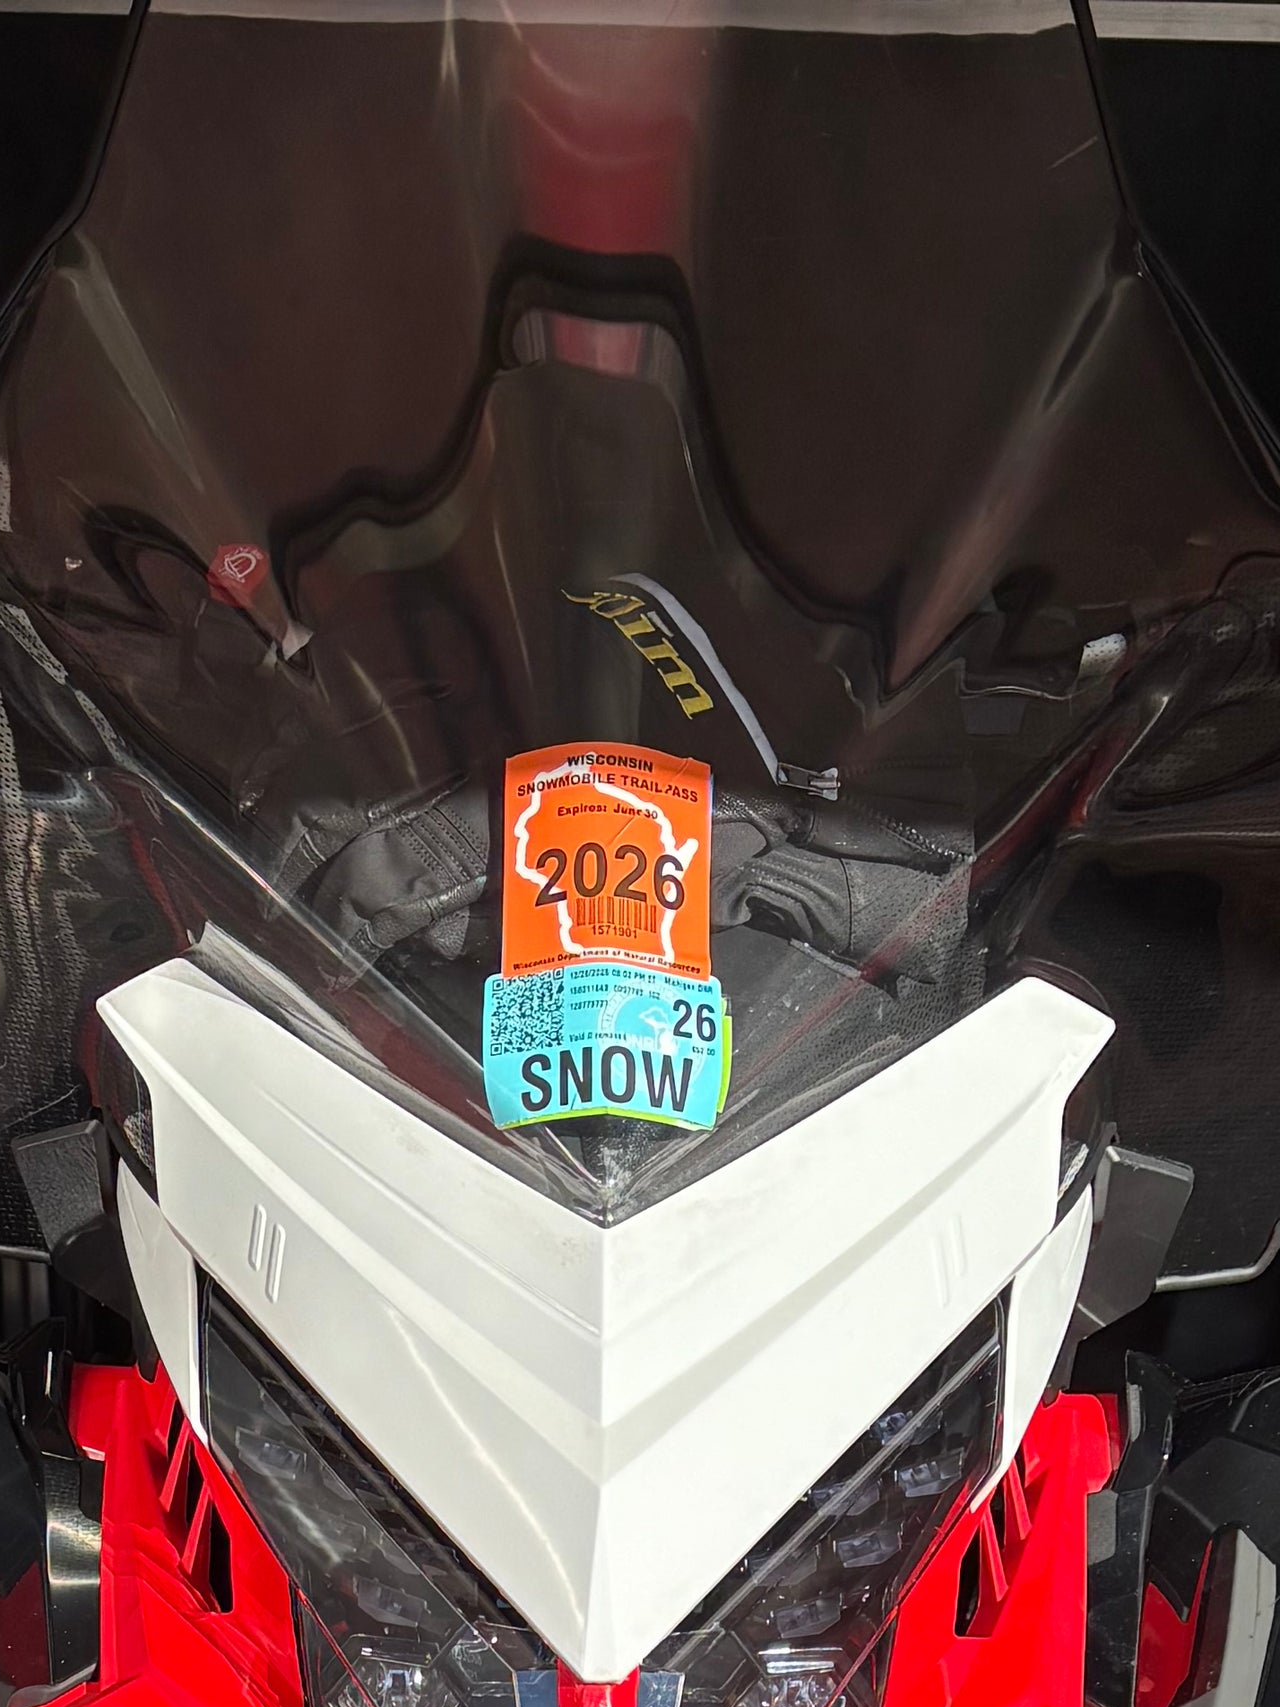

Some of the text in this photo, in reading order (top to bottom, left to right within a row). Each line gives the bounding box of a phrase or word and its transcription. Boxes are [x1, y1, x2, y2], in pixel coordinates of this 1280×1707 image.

[567, 754, 653, 773] WISCONSIN
[517, 773, 699, 803] SNOWMOBILE TRAIL PASS
[557, 803, 659, 820] Expires: June 30
[535, 842, 685, 911] 2026
[592, 924, 638, 939] 1571901
[513, 956, 556, 971] Wisconsin
[657, 957, 701, 974] Resources
[673, 999, 717, 1042] 26
[521, 1045, 694, 1113] SNOW
